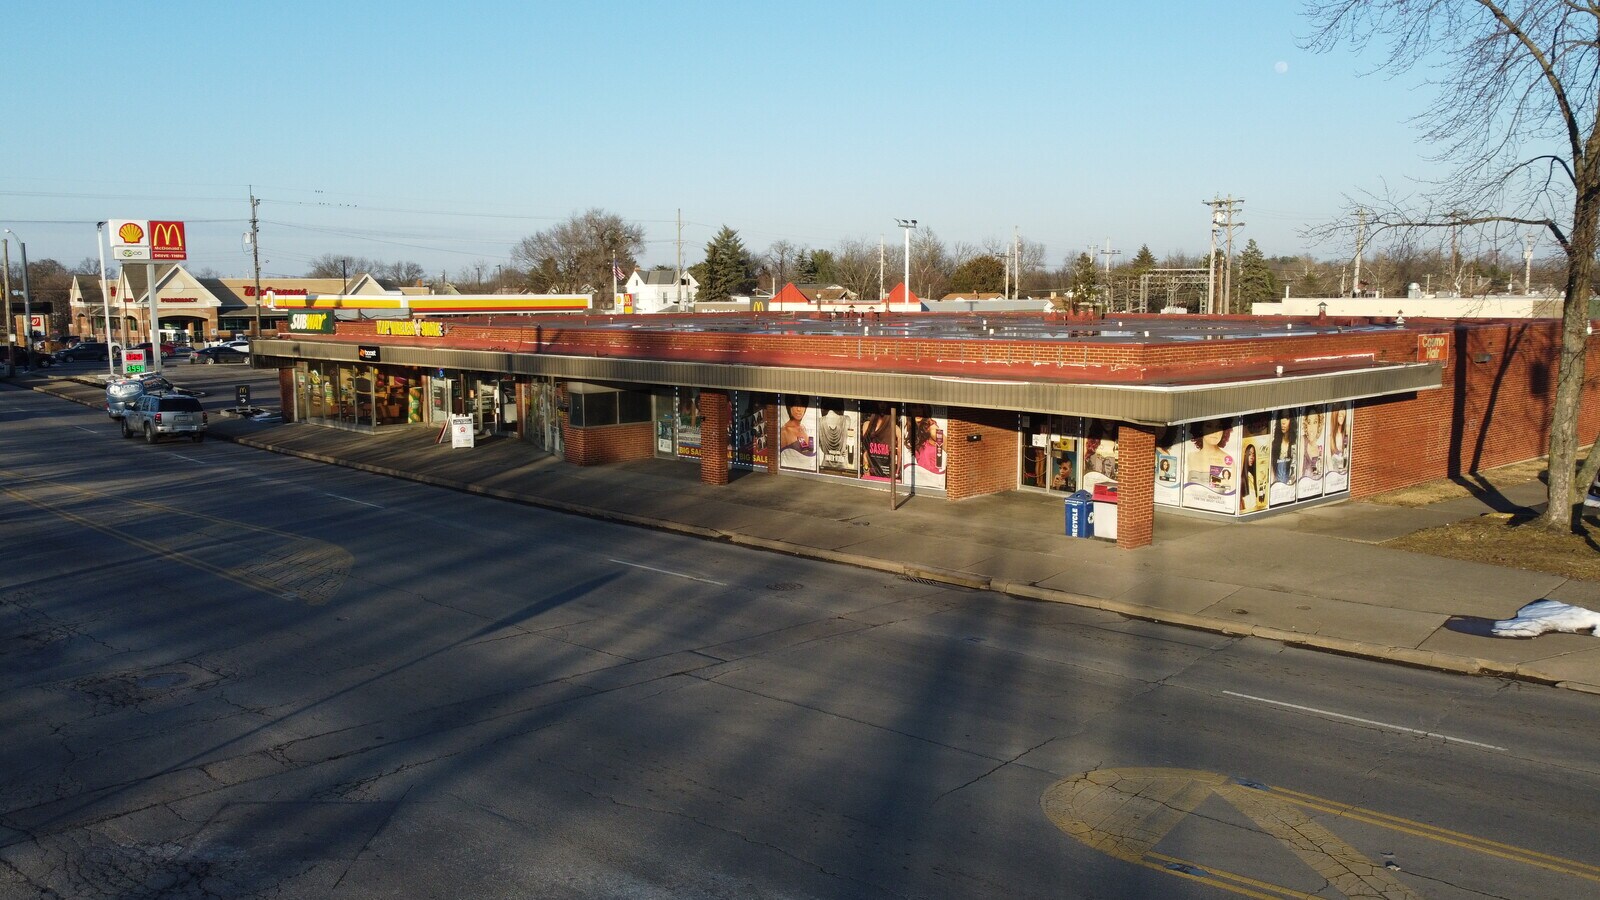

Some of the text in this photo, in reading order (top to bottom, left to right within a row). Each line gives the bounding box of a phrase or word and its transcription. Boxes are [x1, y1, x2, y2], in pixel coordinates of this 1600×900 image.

[243, 286, 308, 297] Walreens
[290, 313, 327, 330] SUBWAY
[1422, 335, 1445, 348] Cosmo
[365, 349, 377, 357] boost
[1426, 347, 1440, 359] Hair
[679, 446, 702, 456] BIG SAL
[870, 442, 889, 456] SASHA
[739, 452, 751, 461] BIG
